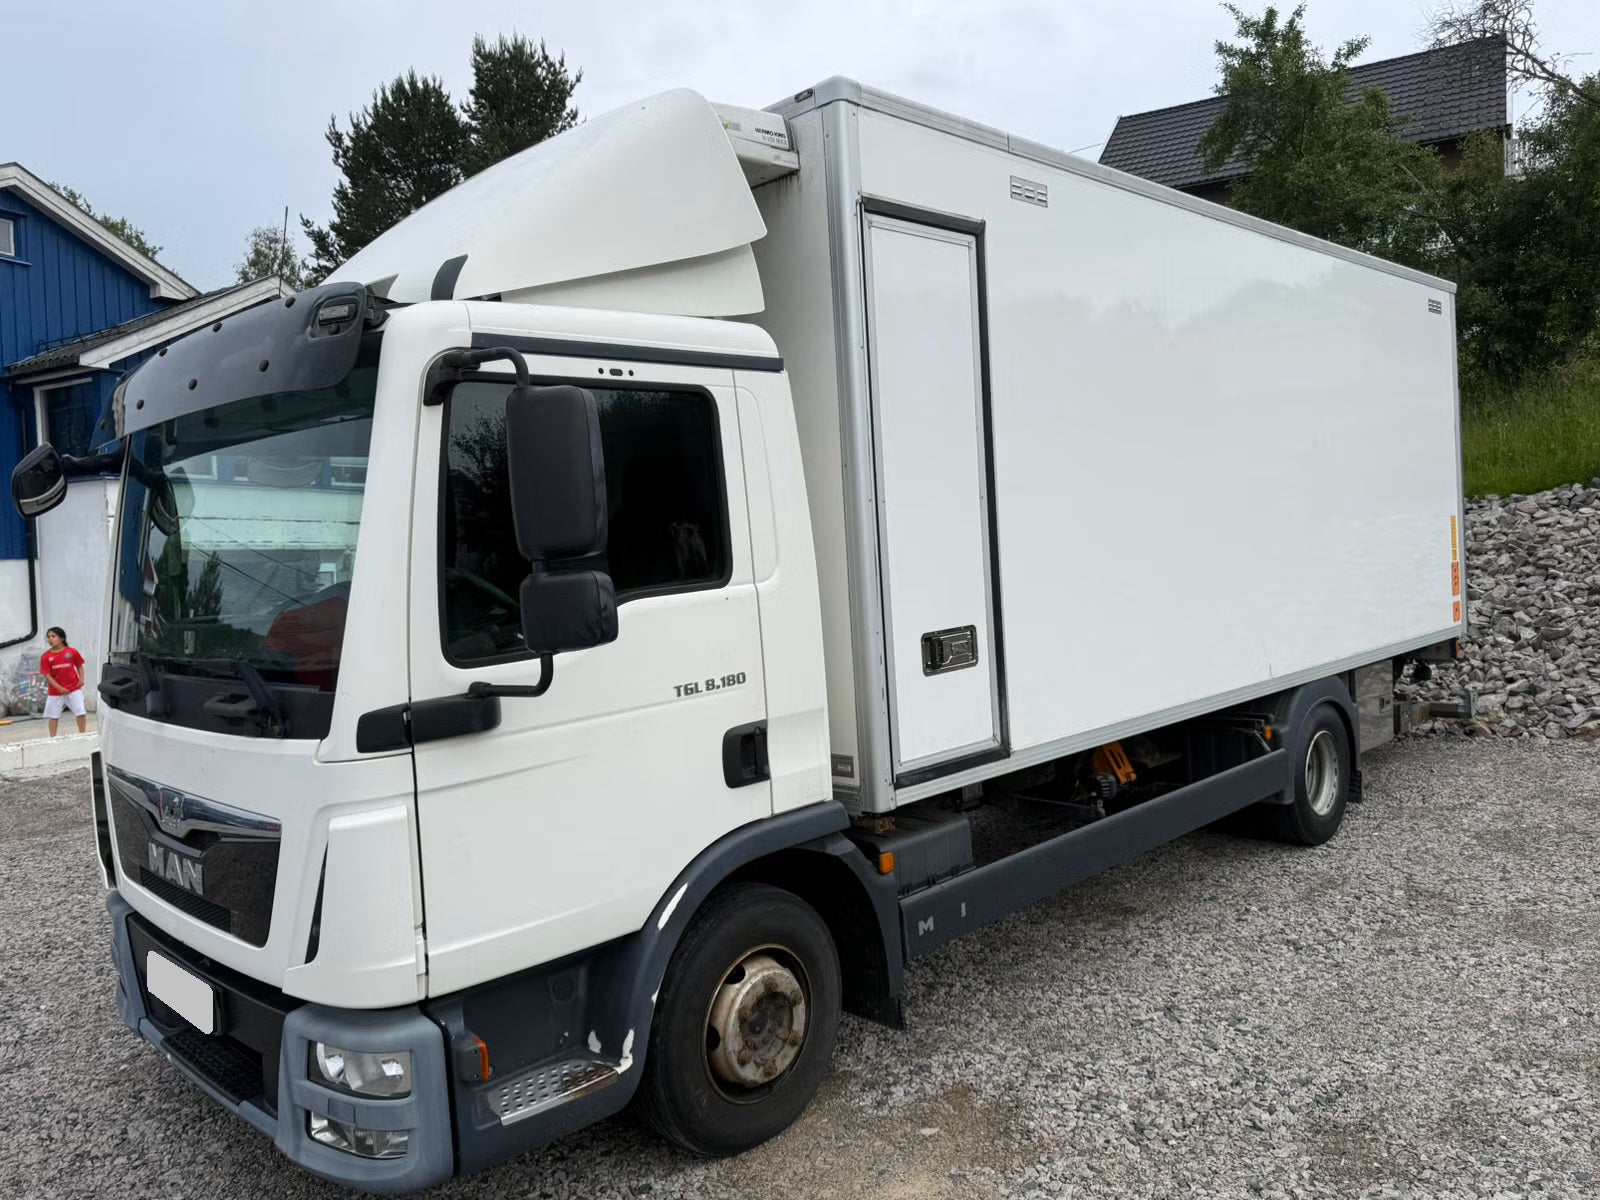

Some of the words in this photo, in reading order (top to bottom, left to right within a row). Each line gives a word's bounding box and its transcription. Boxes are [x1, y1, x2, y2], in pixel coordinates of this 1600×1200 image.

[673, 682, 703, 697] TGL
[705, 672, 746, 691] 8.180
[147, 842, 204, 895] MAN
